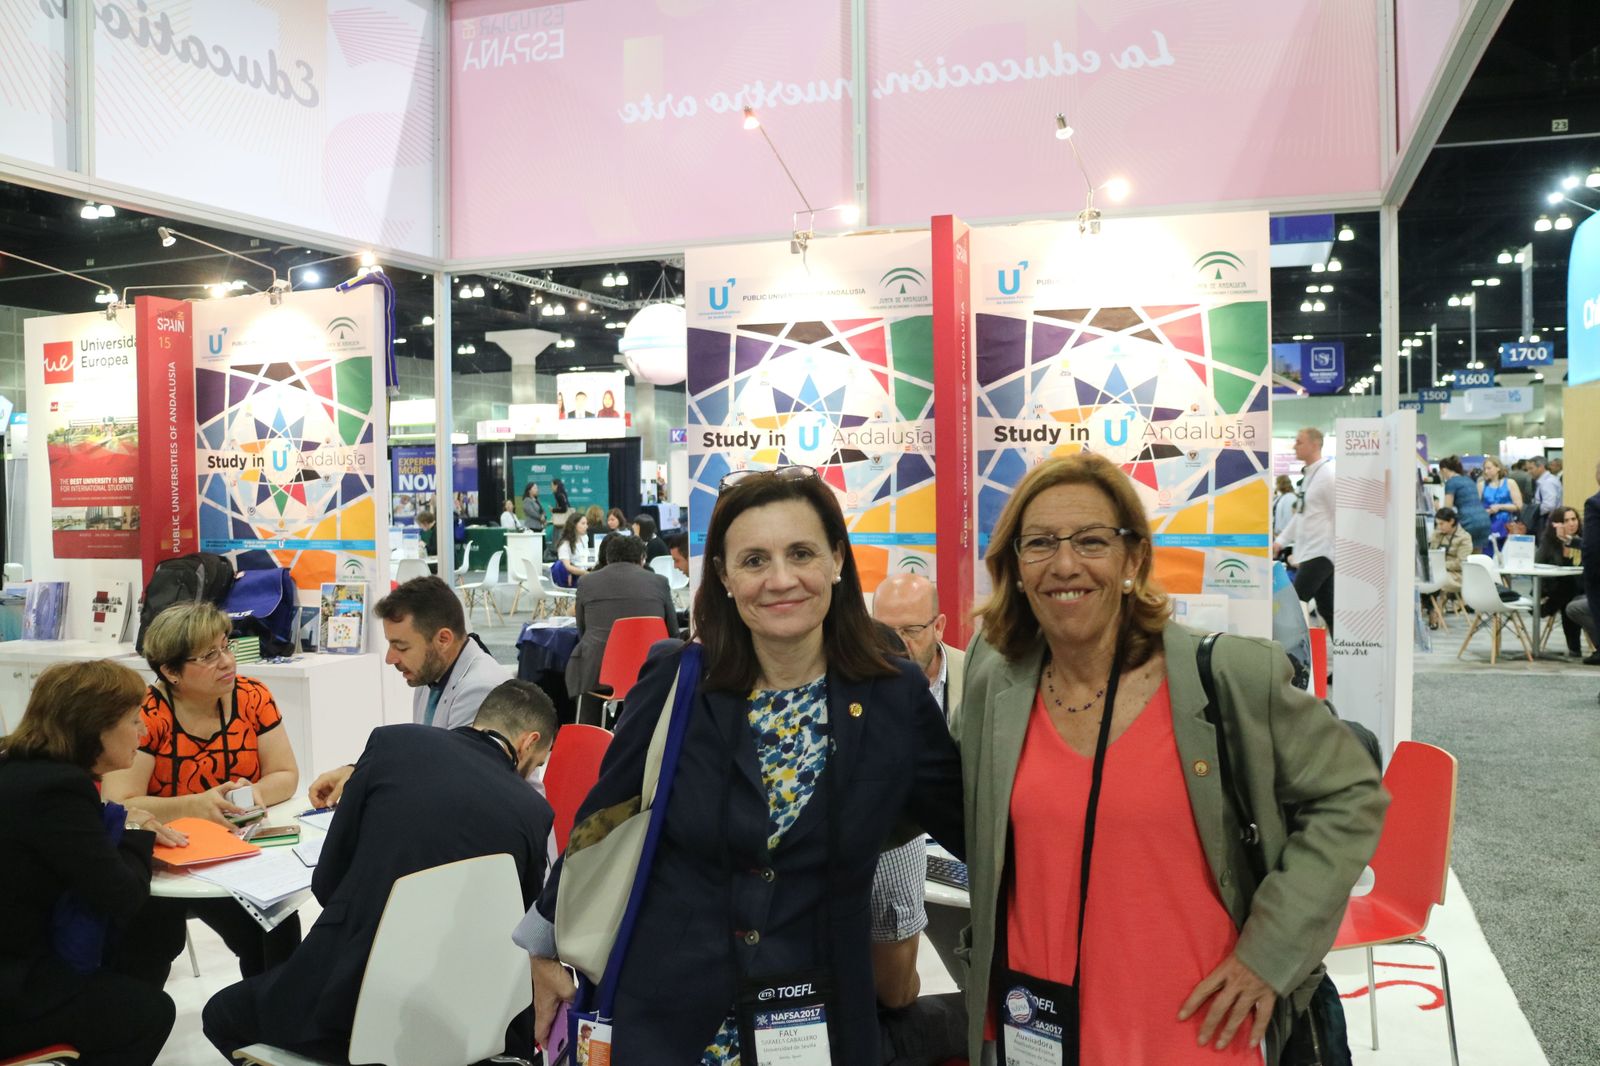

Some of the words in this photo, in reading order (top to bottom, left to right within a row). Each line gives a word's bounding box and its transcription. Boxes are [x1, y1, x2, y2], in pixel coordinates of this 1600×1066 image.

[157, 317, 185, 333] SPAIN
[158, 336, 171, 349] 15
[1509, 347, 1547, 362] 1700
[81, 355, 129, 369] Europea
[1459, 373, 1489, 385] 1600
[168, 361, 177, 423] ANDALUSIA
[1423, 390, 1448, 400] 1500
[169, 425, 177, 440] OF
[994, 425, 1062, 445] Study
[1070, 424, 1090, 441] in
[1345, 430, 1370, 438] STUDY
[703, 430, 761, 450] Study
[769, 430, 786, 446] in
[1345, 439, 1380, 450] SPAIN
[207, 454, 247, 471] Study
[252, 454, 265, 468] in
[398, 457, 436, 466] EXPERIEN
[398, 465, 424, 474] MORE
[70, 477, 82, 485] BEST
[83, 477, 112, 485] UNIVERSITY
[118, 476, 134, 484] SPAIN
[170, 442, 180, 513] UNIVERSITIES
[70, 484, 107, 492] INTERNATIONAL
[172, 514, 181, 552] PUBLIC
[1352, 648, 1368, 656] Art
[777, 983, 816, 999] TOEFL
[1032, 996, 1058, 1015] OEFL
[779, 1029, 798, 1037] FALY
[1035, 1020, 1063, 1035] SA2017
